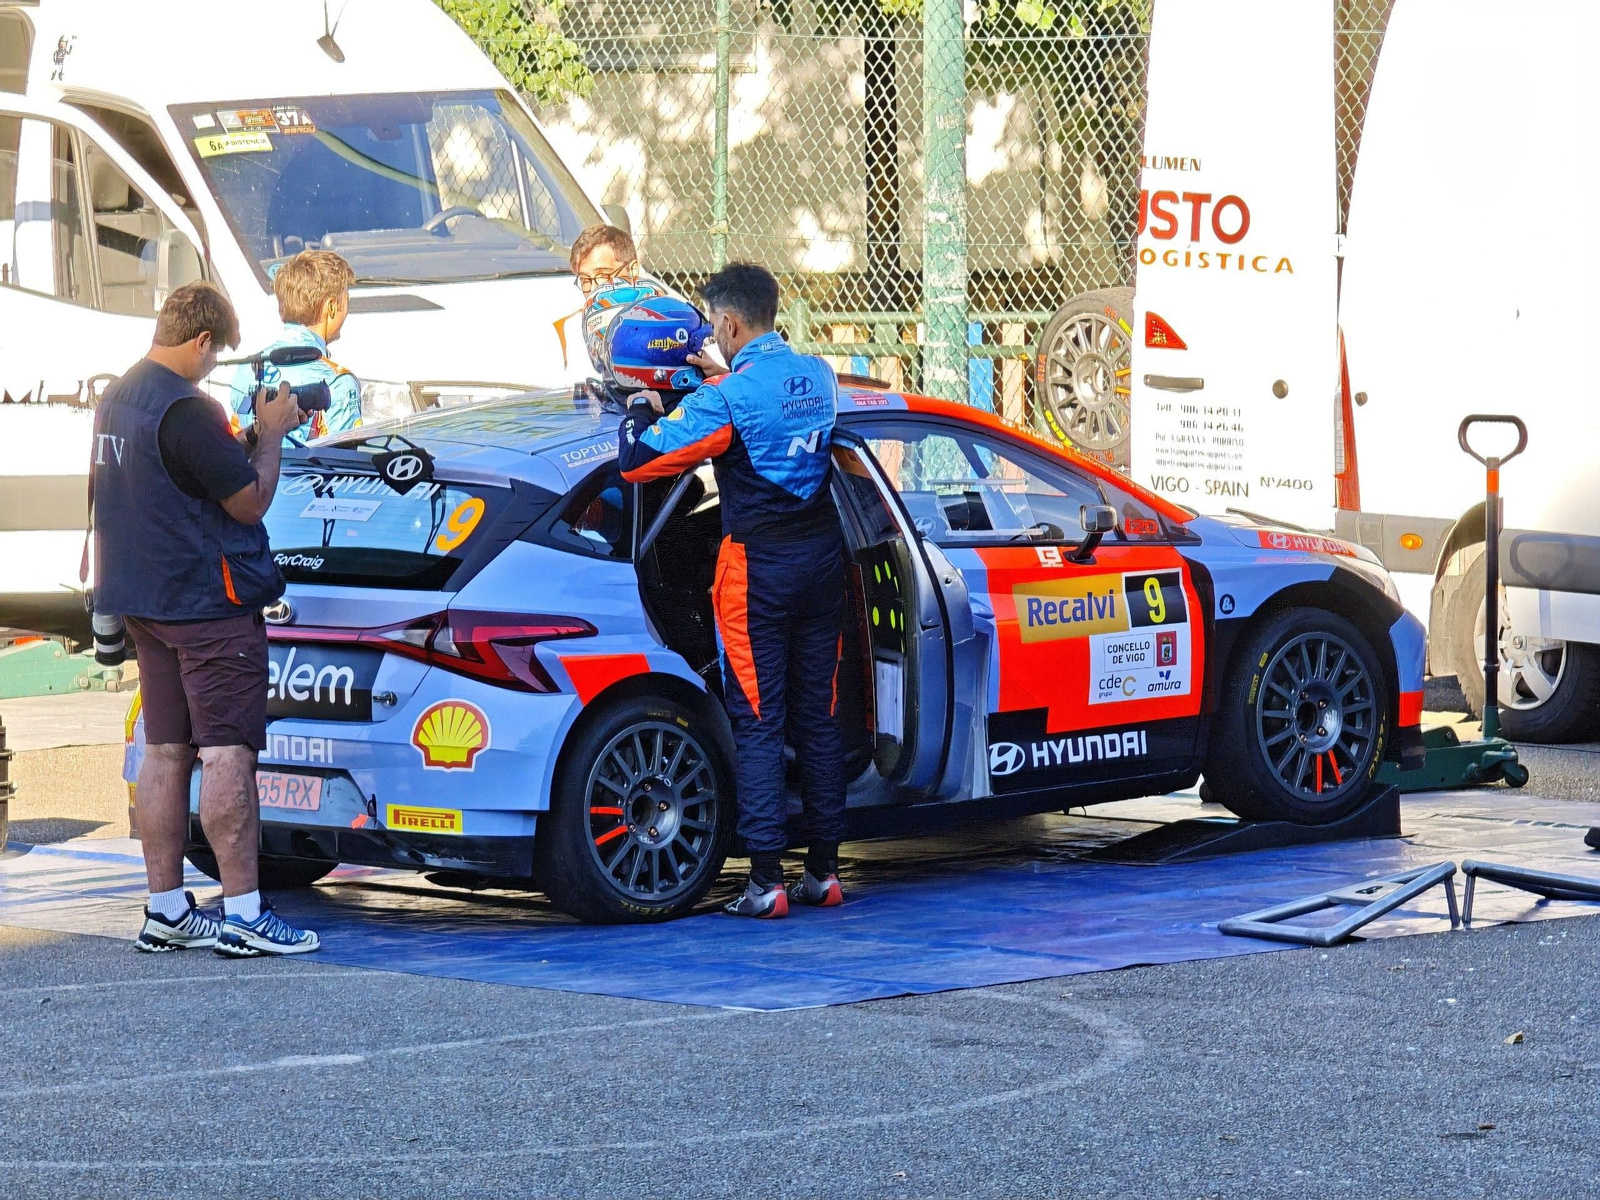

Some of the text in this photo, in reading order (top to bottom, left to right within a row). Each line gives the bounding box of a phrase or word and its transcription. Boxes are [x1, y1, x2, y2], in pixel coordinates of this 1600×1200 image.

[1139, 244, 1294, 274] OGÍSTICA
[782, 396, 824, 411] HYUNDAI
[560, 441, 616, 463] TOPTUL
[1150, 474, 1190, 493] VIGO
[1205, 479, 1249, 498] SPAIN
[436, 497, 486, 552] 9
[1124, 517, 1159, 535] i20
[1026, 589, 1116, 628] Recalvi
[1143, 577, 1166, 624] 9
[1107, 640, 1151, 654] CONCELLO
[1112, 652, 1146, 665] DE VIGO
[1147, 680, 1182, 692] amura
[1031, 729, 1148, 768] HYUNDAI
[393, 808, 455, 830] PIRELLI
